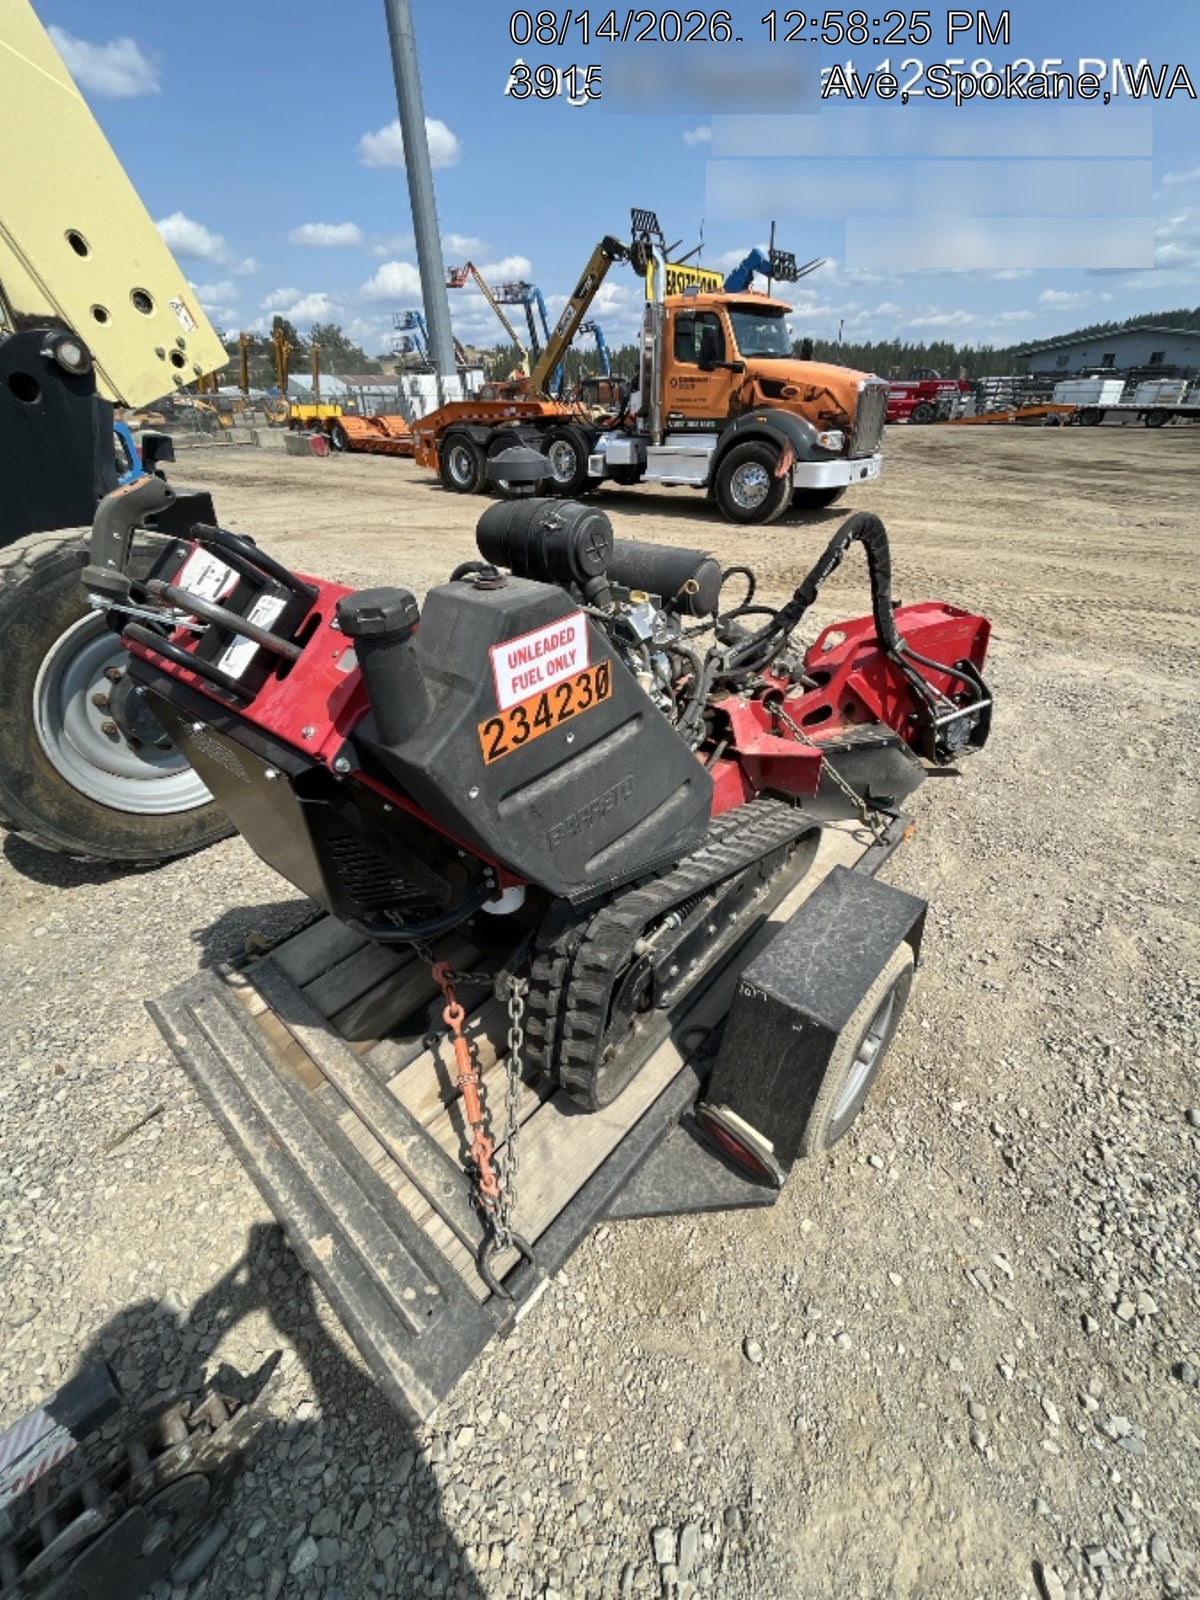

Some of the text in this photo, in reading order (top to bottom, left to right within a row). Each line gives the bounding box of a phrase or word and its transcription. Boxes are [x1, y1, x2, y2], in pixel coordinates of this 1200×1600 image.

[507, 626, 576, 669] UNLEADED
[511, 648, 577, 694] FUEL ONLY
[483, 660, 610, 760] 234230
